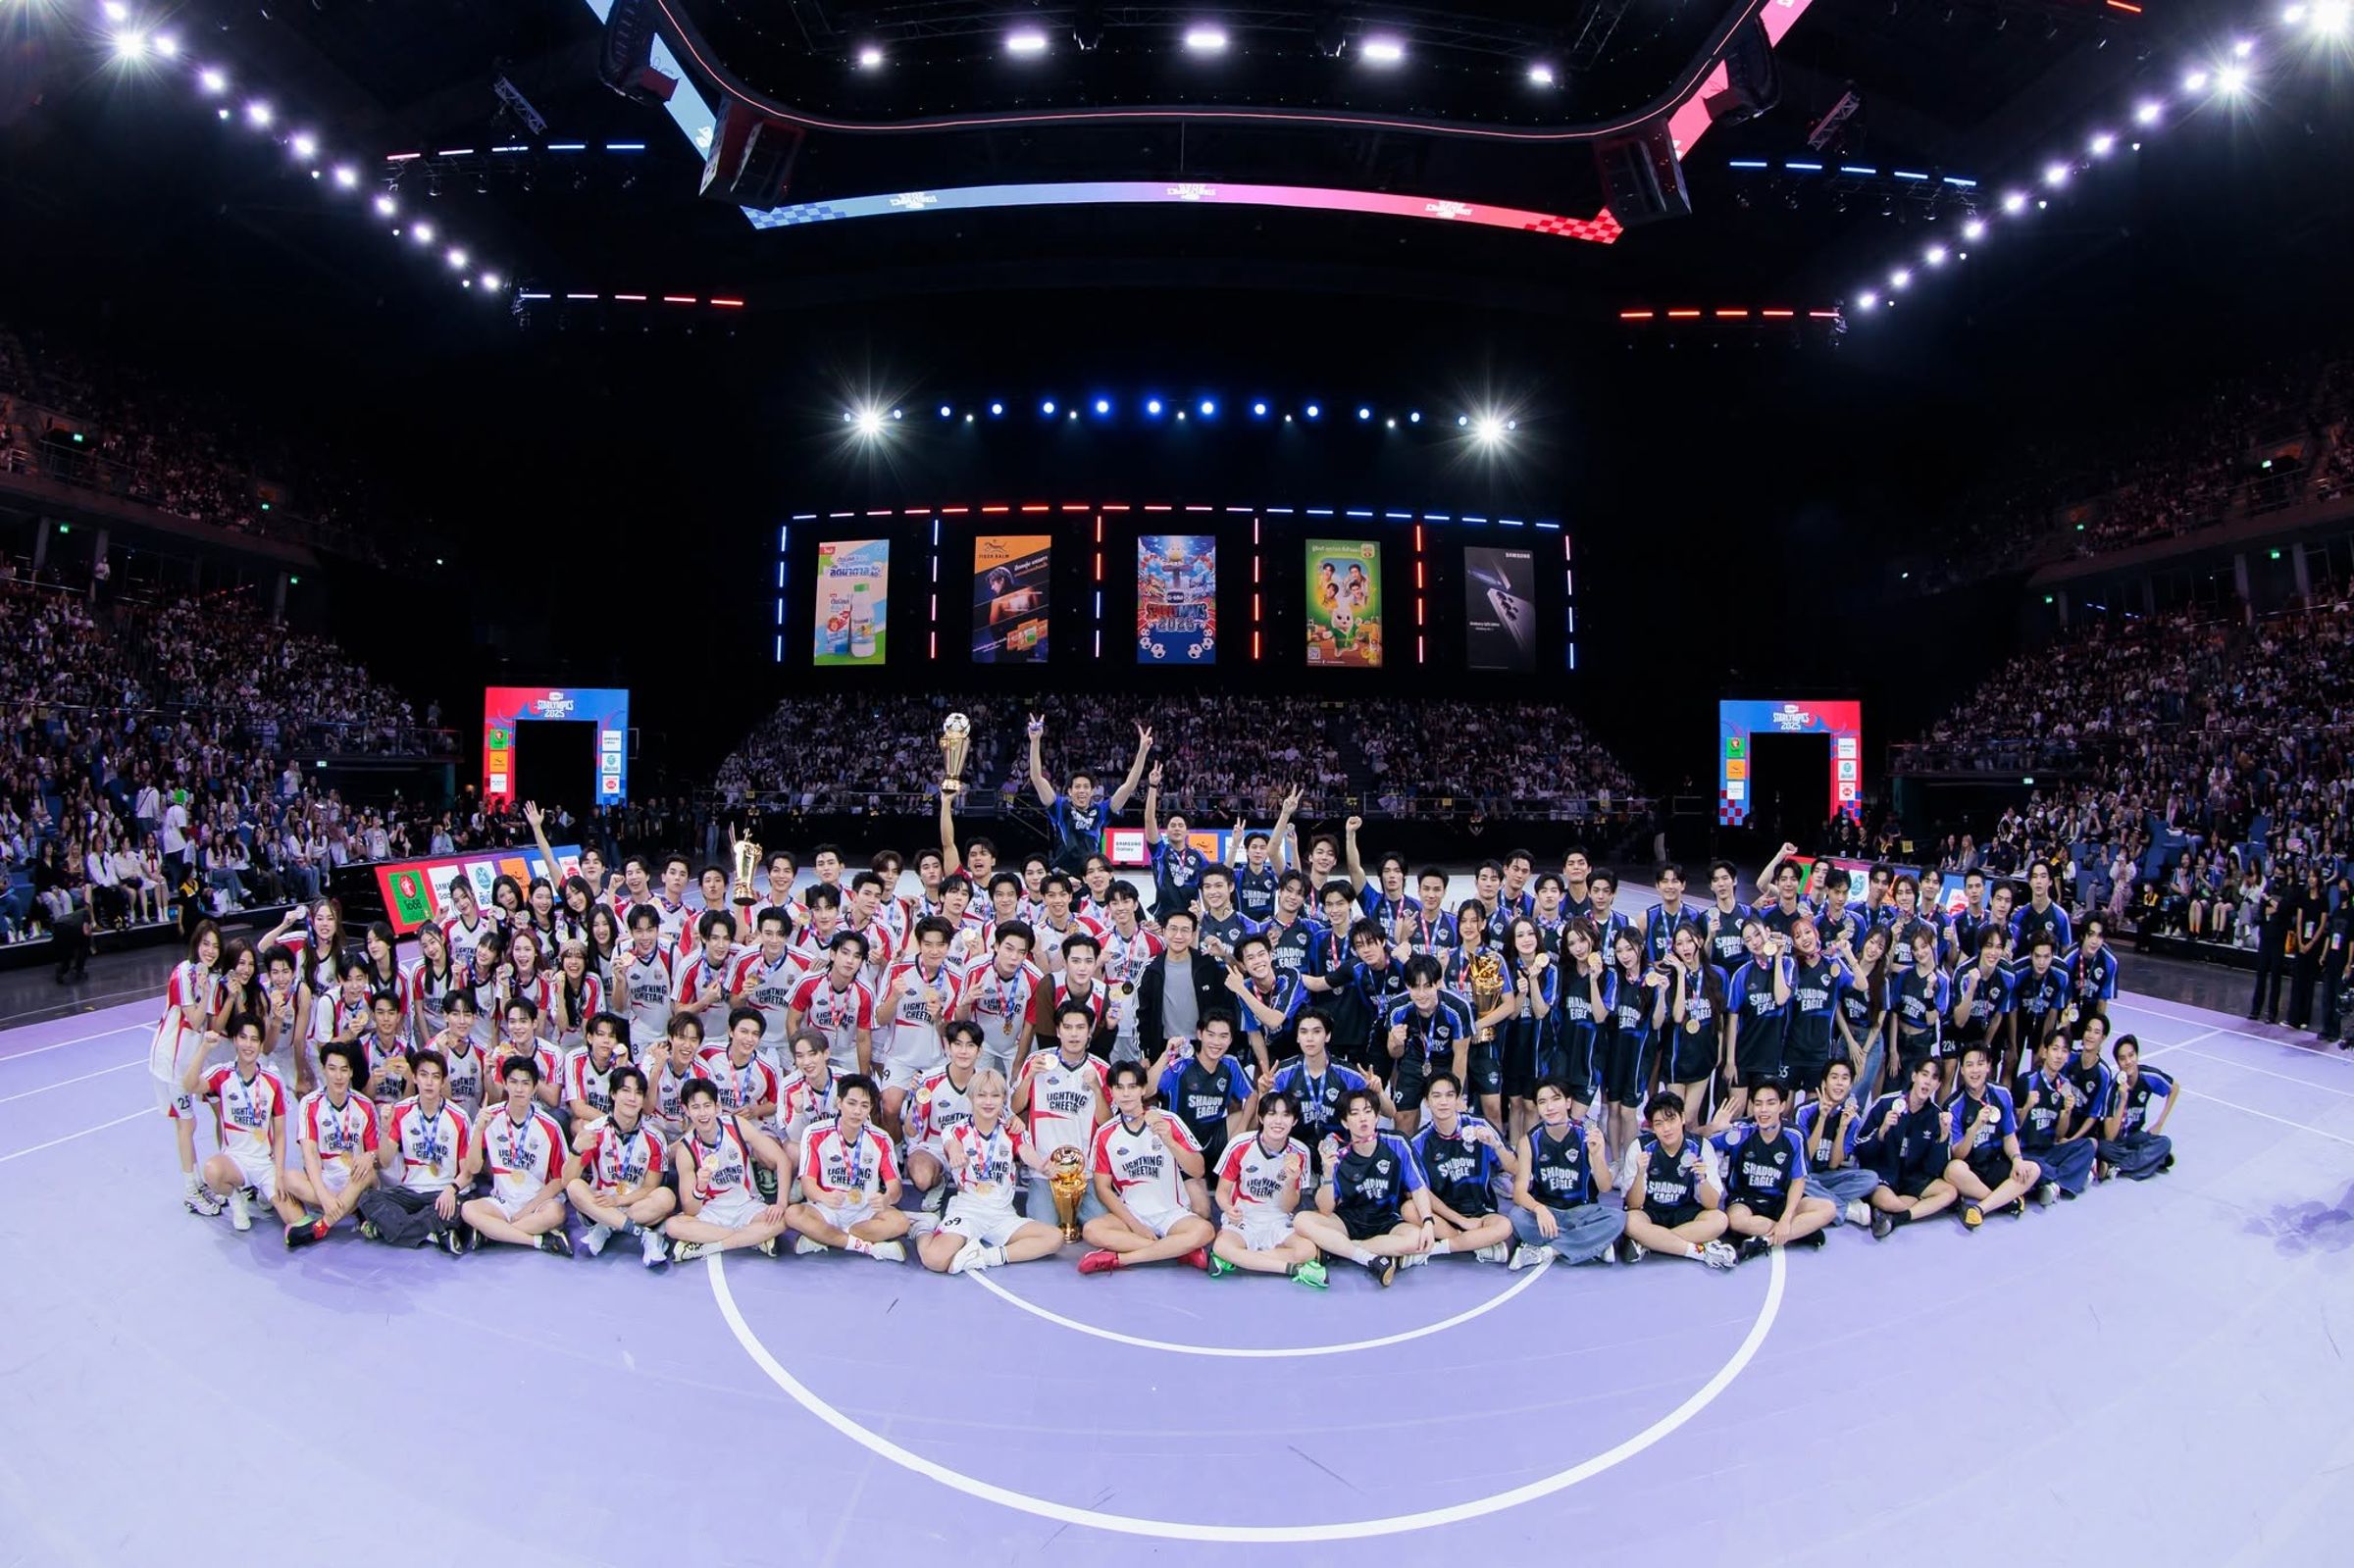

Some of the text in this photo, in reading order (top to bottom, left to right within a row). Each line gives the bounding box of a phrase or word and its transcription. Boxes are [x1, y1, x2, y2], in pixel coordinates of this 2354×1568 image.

[1157, 617, 1195, 631] 2025
[1278, 957, 1302, 968] EAGLE
[631, 985, 667, 996] LIGHTNING
[1796, 988, 1828, 1001] SHADOW
[1801, 998, 1822, 1011] EAGLE
[1188, 1094, 1223, 1108] SHADOW
[1196, 1105, 1219, 1119] EAGLE
[1121, 1155, 1162, 1172] LIGHTNING
[1743, 1161, 1782, 1180] SHADOW
[1648, 1181, 1687, 1194] SHADOW
[1749, 1175, 1774, 1187] EAGLE
[1653, 1192, 1679, 1204] EAGLE
